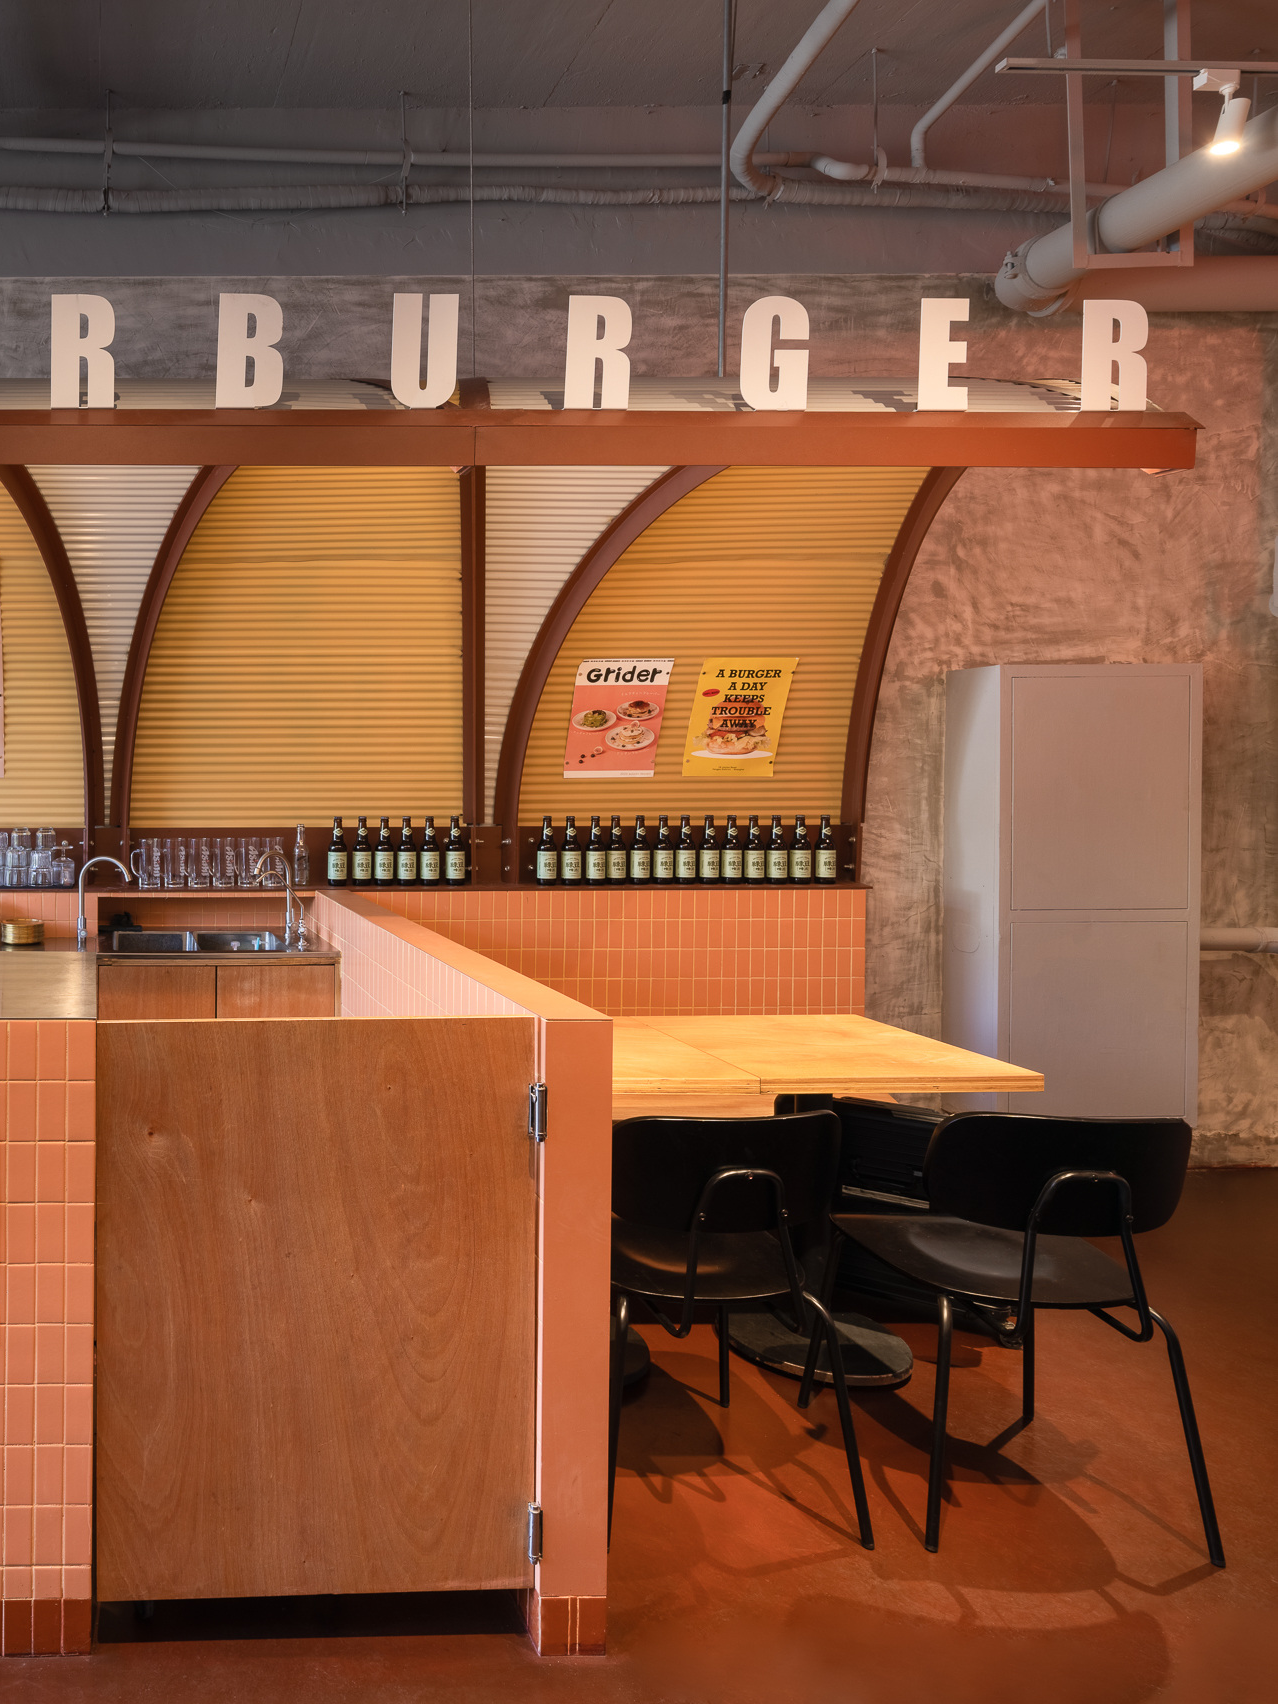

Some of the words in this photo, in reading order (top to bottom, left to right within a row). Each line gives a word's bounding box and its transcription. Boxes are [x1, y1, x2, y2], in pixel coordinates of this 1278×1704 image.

[586, 665, 663, 684] Grider
[715, 669, 726, 678] A
[729, 669, 782, 679] BURGER
[727, 682, 737, 691] A
[739, 682, 768, 691] DAY
[722, 694, 765, 703] KEEPS
[711, 706, 771, 716] TROUBLE
[720, 719, 757, 728] AWAY
